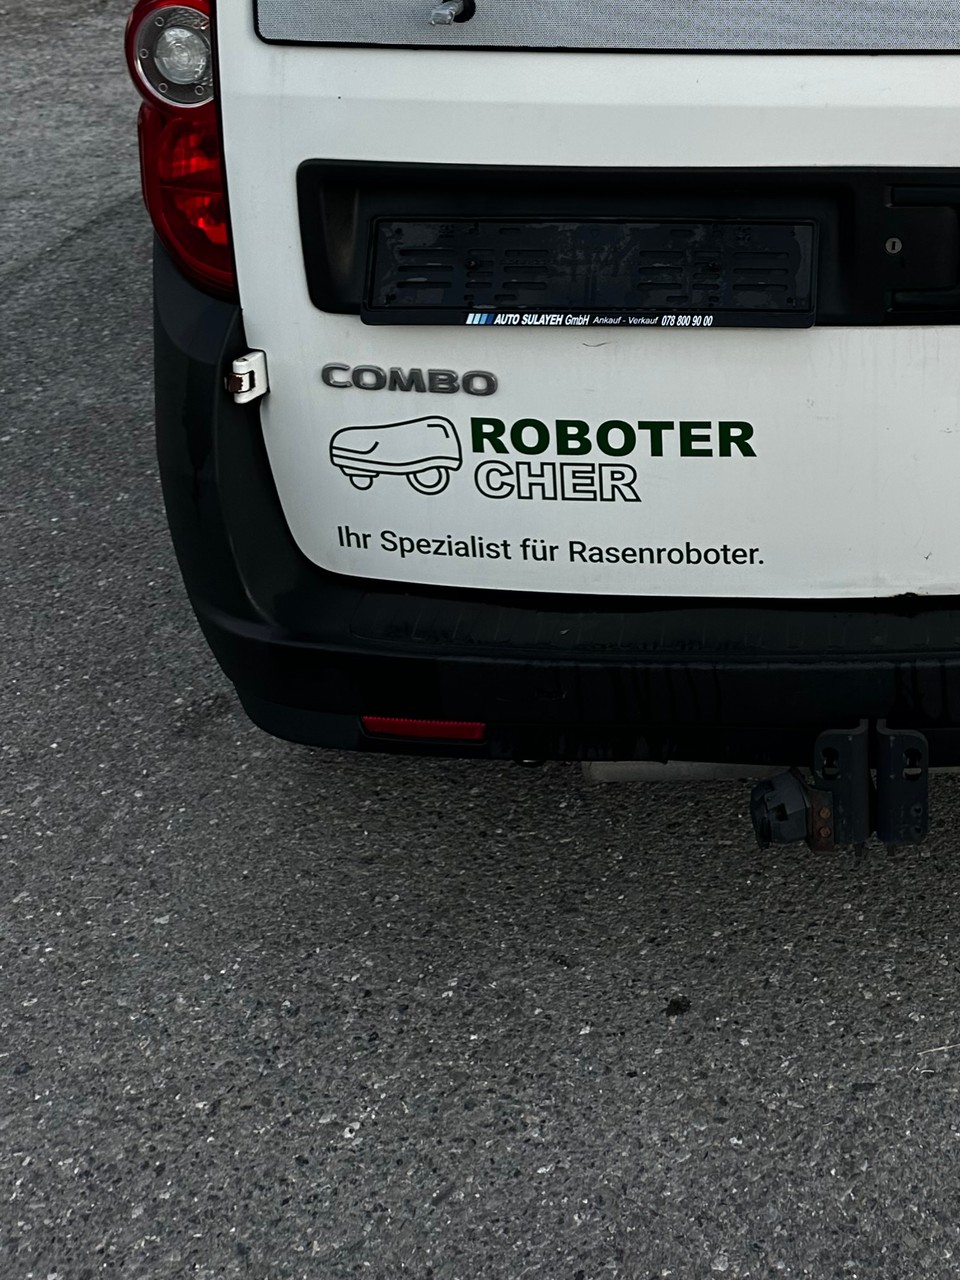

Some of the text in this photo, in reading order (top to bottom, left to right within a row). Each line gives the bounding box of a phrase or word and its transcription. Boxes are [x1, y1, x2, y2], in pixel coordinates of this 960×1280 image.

[493, 314, 520, 325] AUTO
[521, 314, 564, 326] SULAYEH
[564, 314, 590, 326] GmbH
[592, 316, 622, 325] Ankauf
[628, 316, 659, 325] Verkauf
[661, 315, 675, 326] 078
[676, 315, 691, 327] 800
[691, 315, 702, 327] 90
[703, 315, 713, 327] 00
[320, 362, 499, 397] COMBO
[470, 417, 757, 458] ROBOTER
[474, 461, 642, 502] CHER
[337, 526, 764, 565] Ihr Spezialist für Rasenroboter.
